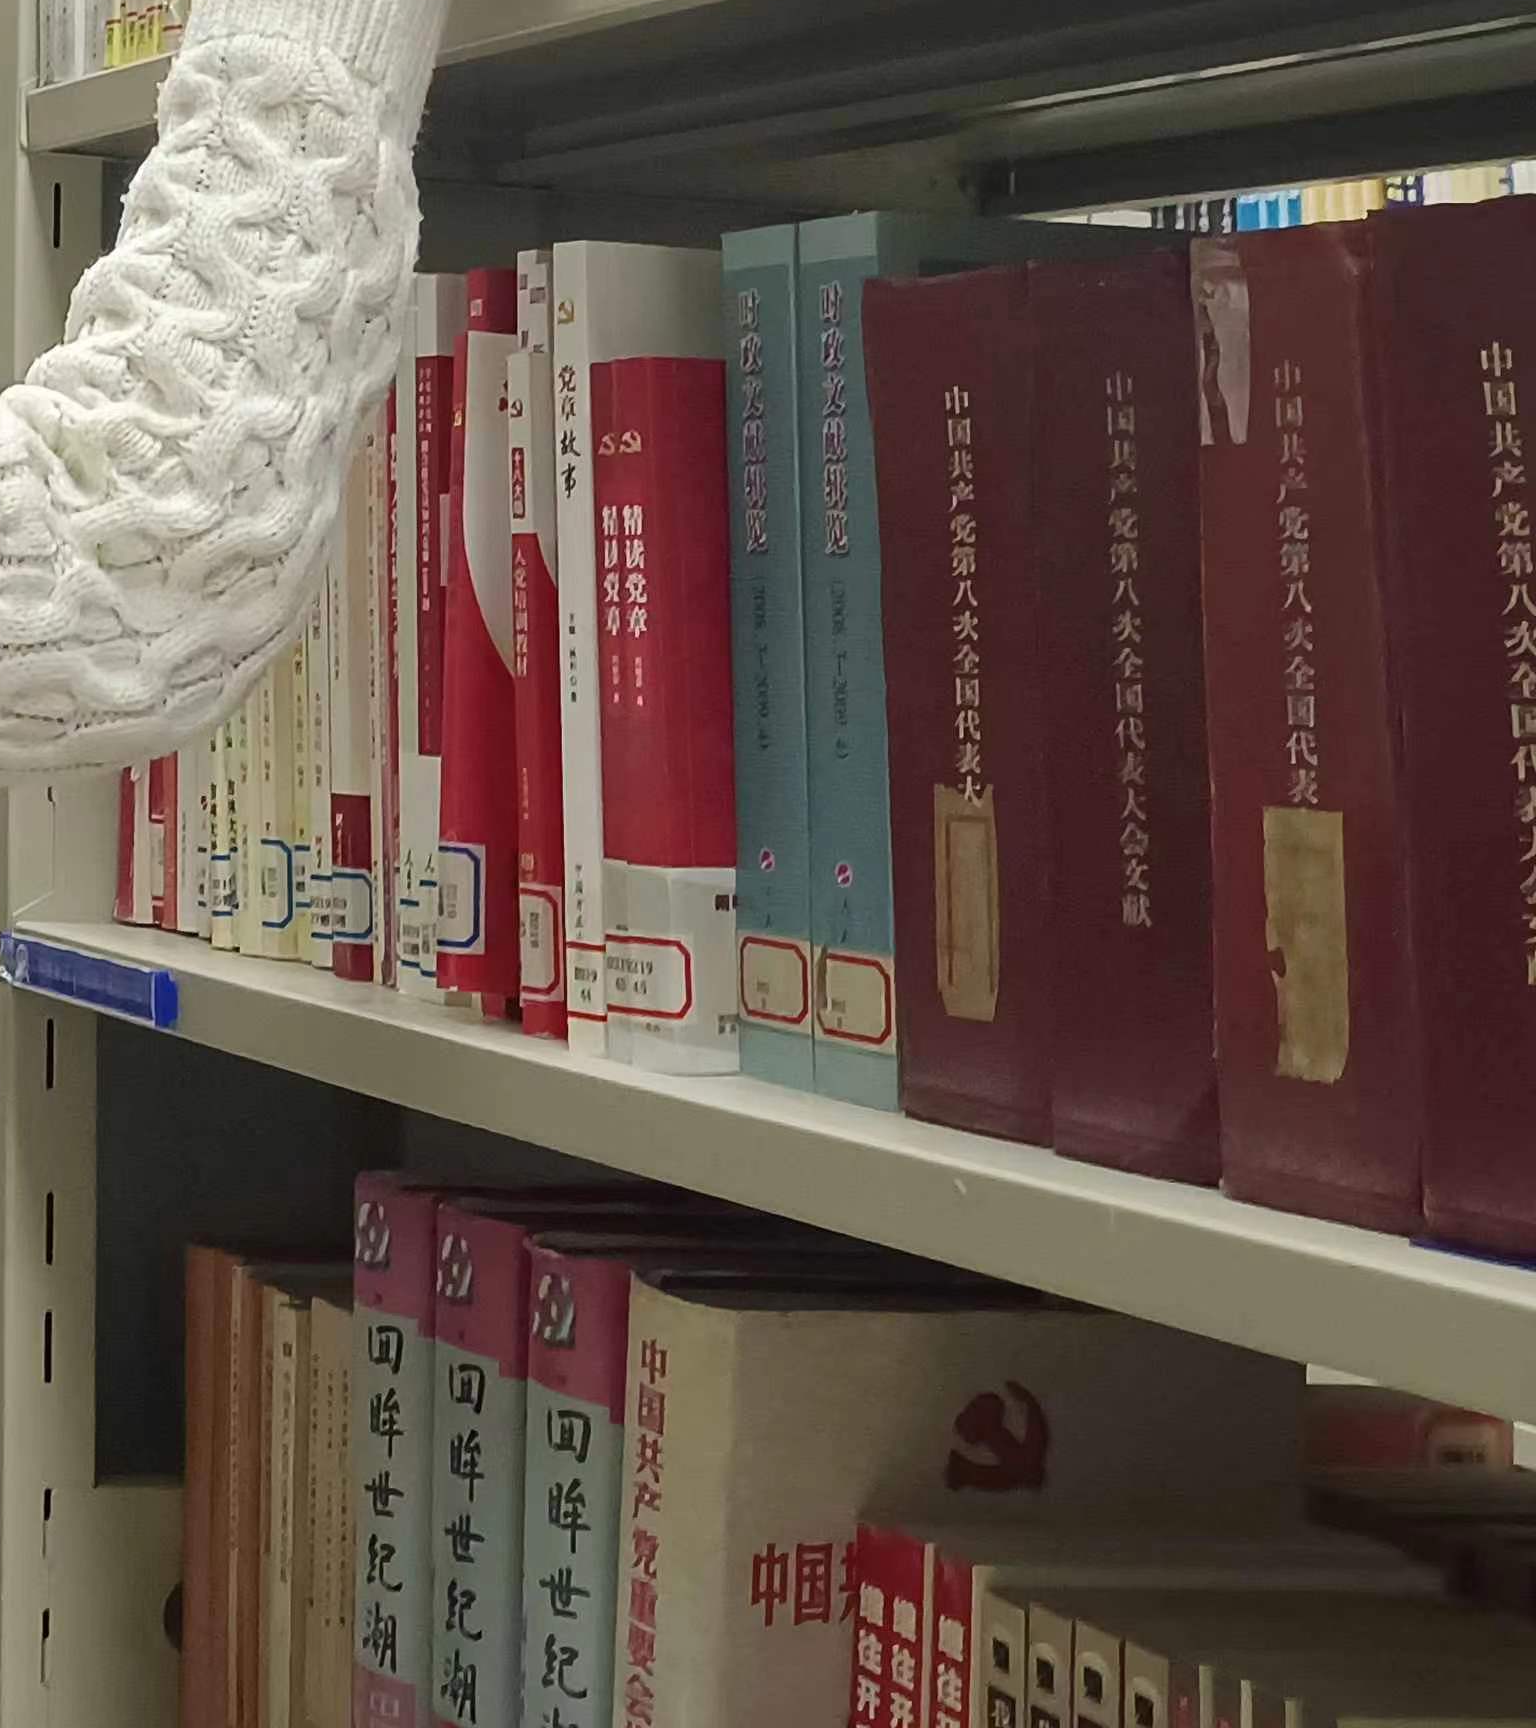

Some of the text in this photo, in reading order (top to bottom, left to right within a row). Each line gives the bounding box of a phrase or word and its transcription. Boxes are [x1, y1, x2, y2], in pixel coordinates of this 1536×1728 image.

[622, 503, 648, 639] 精读党章
[1105, 370, 1154, 929] 中国共产党第八次全国代表大会文献
[1273, 358, 1321, 807] 中国共产党第八次全国代表
[362, 1324, 404, 1674] 回眸世纪潮
[440, 1363, 485, 1725] 回眸世纪潮
